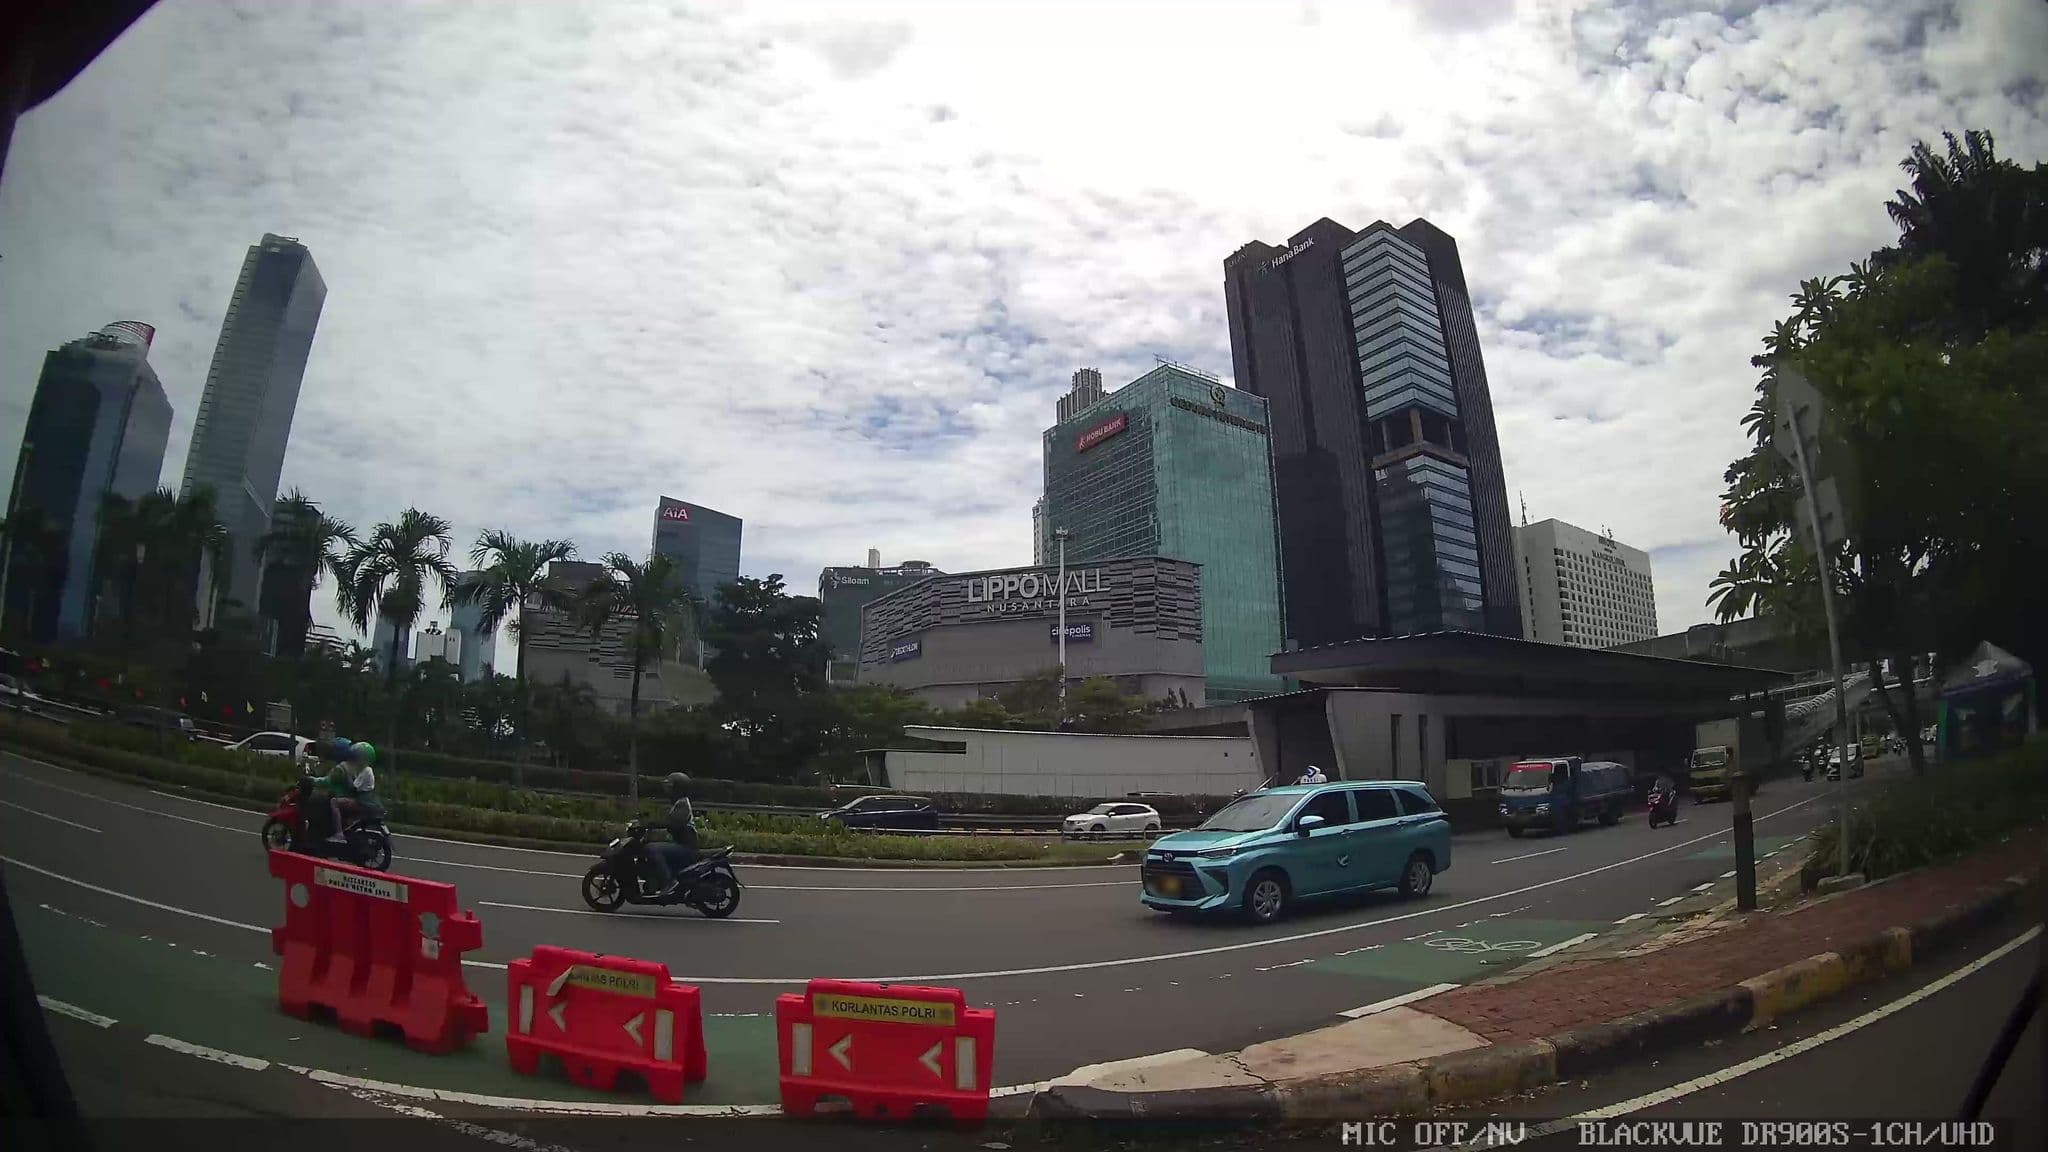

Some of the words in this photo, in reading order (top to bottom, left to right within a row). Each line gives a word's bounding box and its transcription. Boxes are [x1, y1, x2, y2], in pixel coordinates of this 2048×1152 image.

[841, 576, 870, 585] Siloam
[832, 1000, 899, 1016] KORLANTAS
[901, 1006, 936, 1019] POLRI
